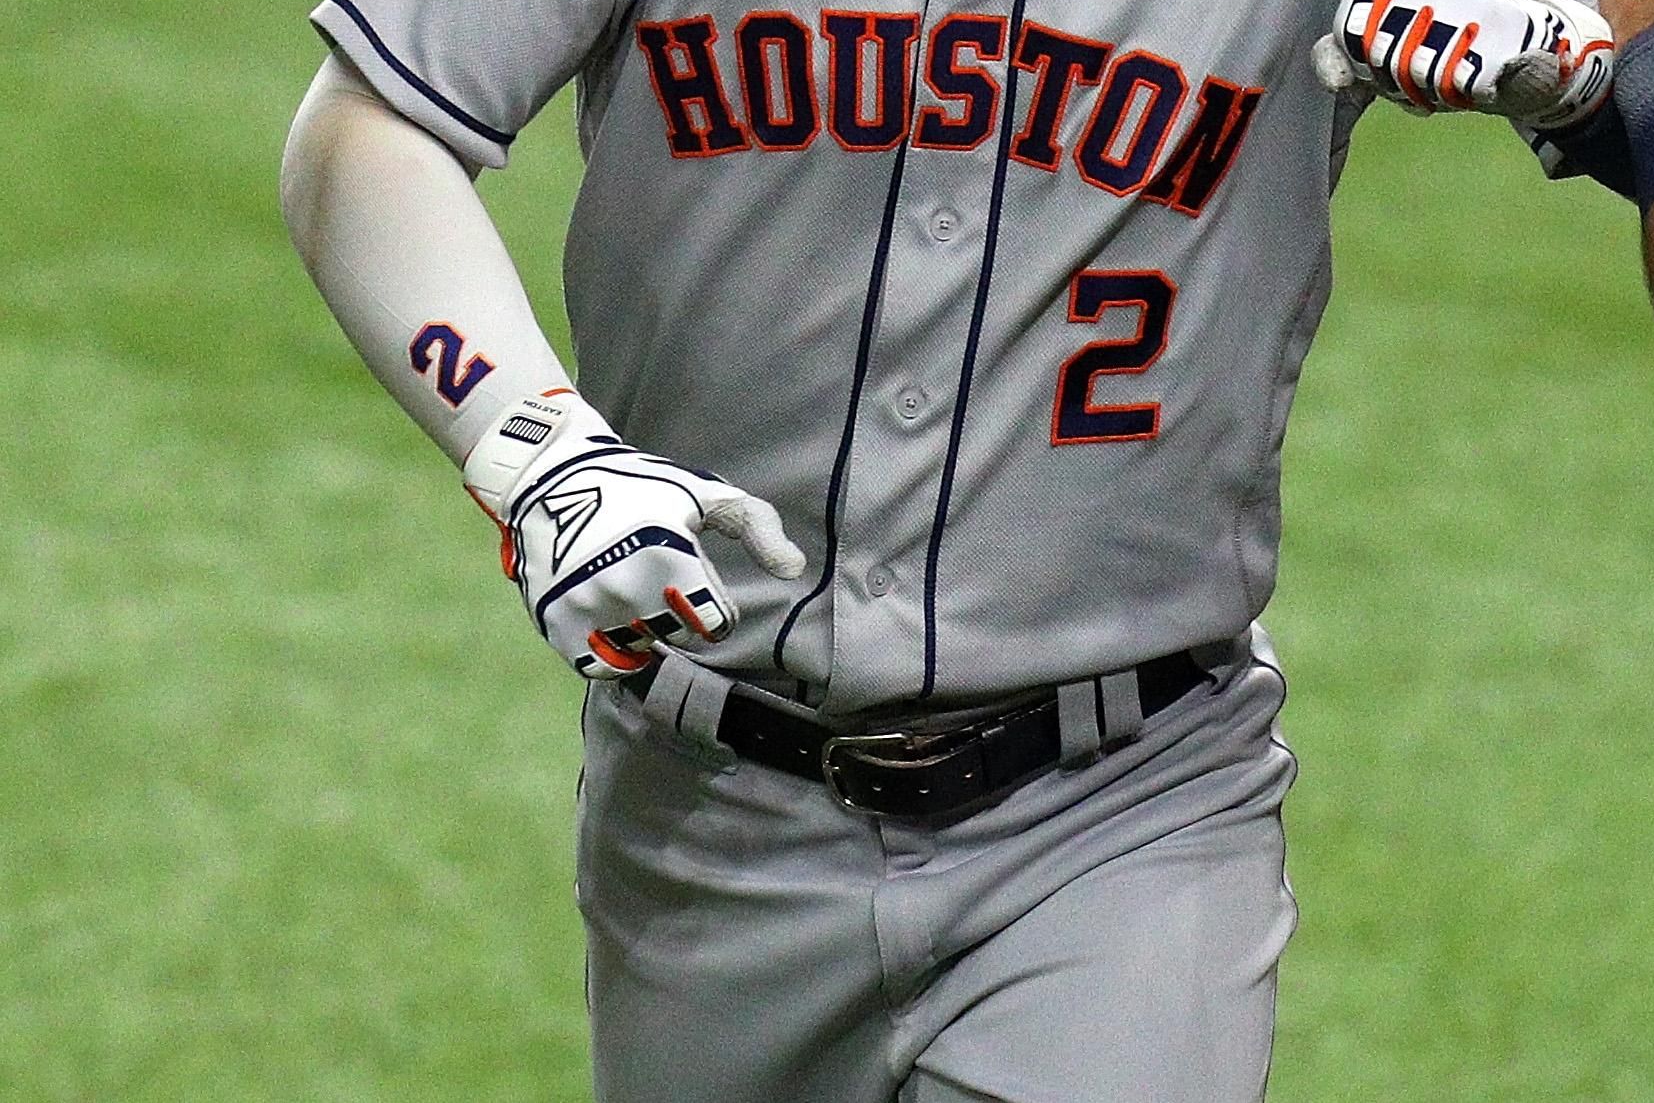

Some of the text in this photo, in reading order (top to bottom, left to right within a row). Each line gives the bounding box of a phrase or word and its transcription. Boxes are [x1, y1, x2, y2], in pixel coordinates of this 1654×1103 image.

[635, 8, 1265, 218] HOUSTON
[409, 319, 497, 409] 2
[1050, 269, 1177, 446] 2
